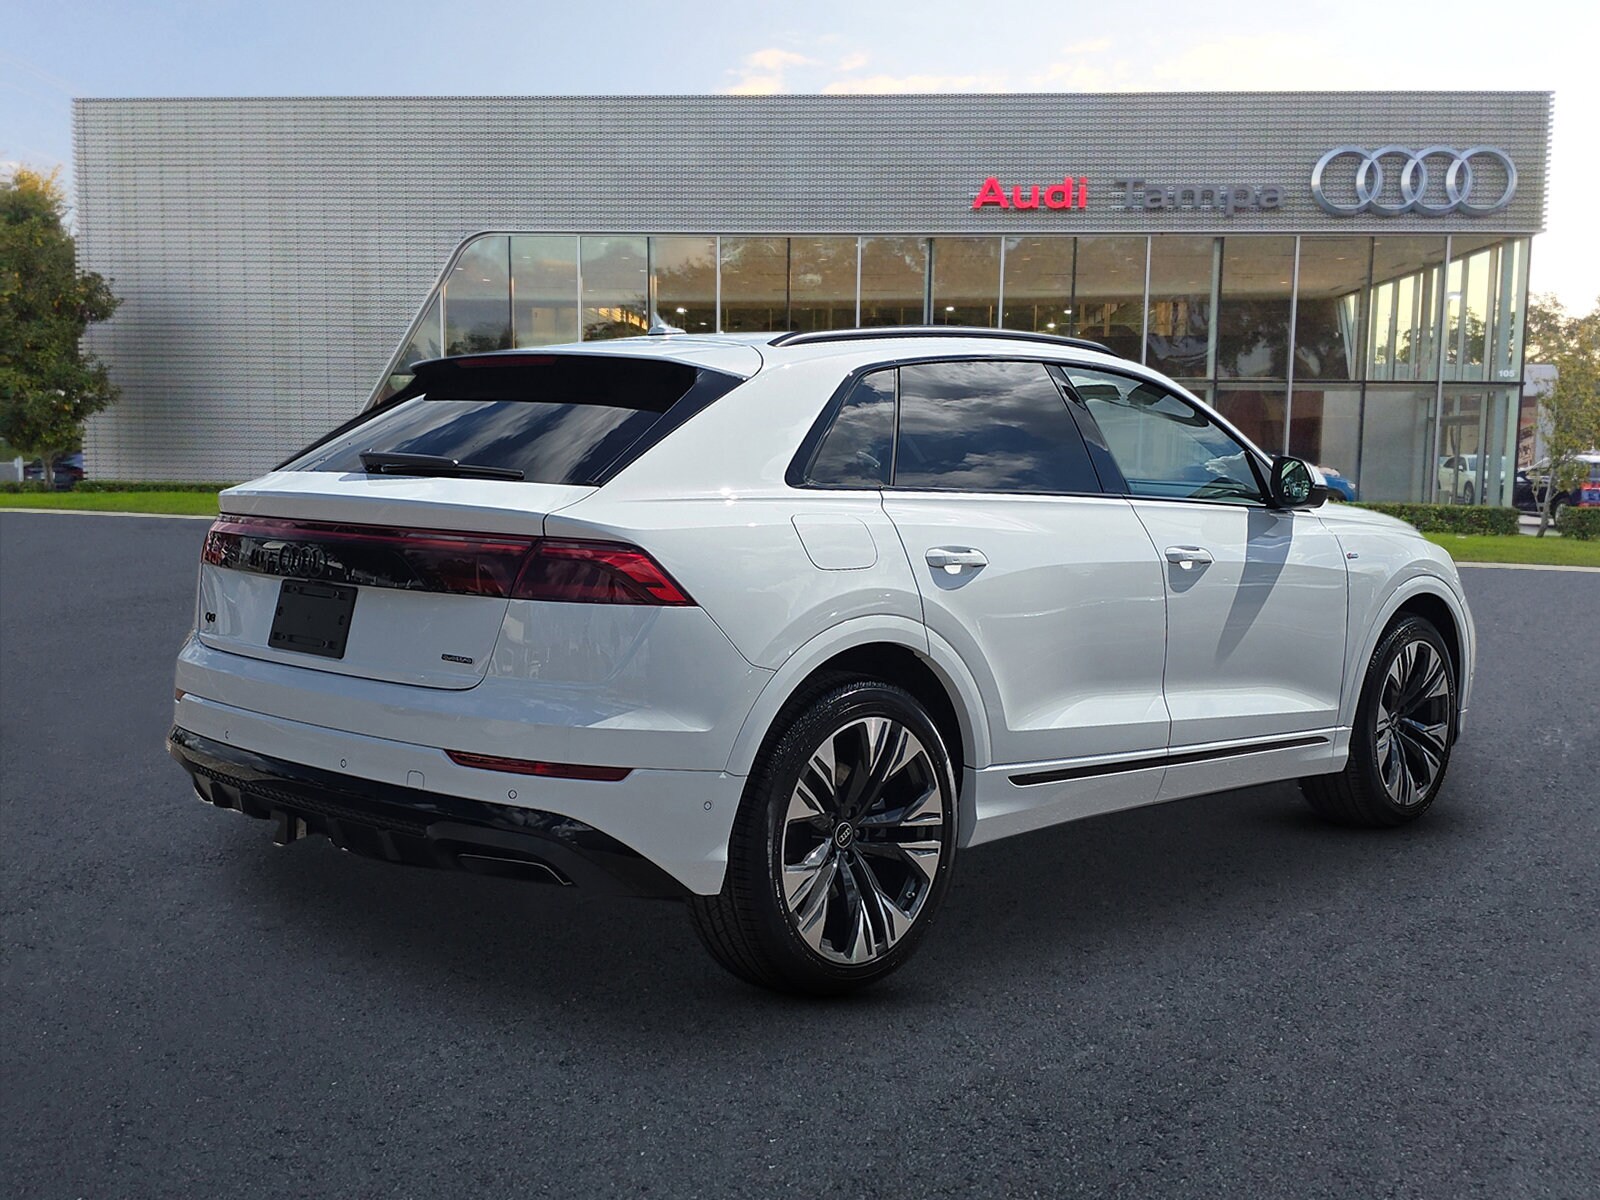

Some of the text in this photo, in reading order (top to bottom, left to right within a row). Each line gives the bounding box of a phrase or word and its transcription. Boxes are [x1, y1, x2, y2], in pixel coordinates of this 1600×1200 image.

[972, 177, 1286, 217] Audi Tampa
[1498, 370, 1515, 378] 105
[205, 611, 216, 623] Q8
